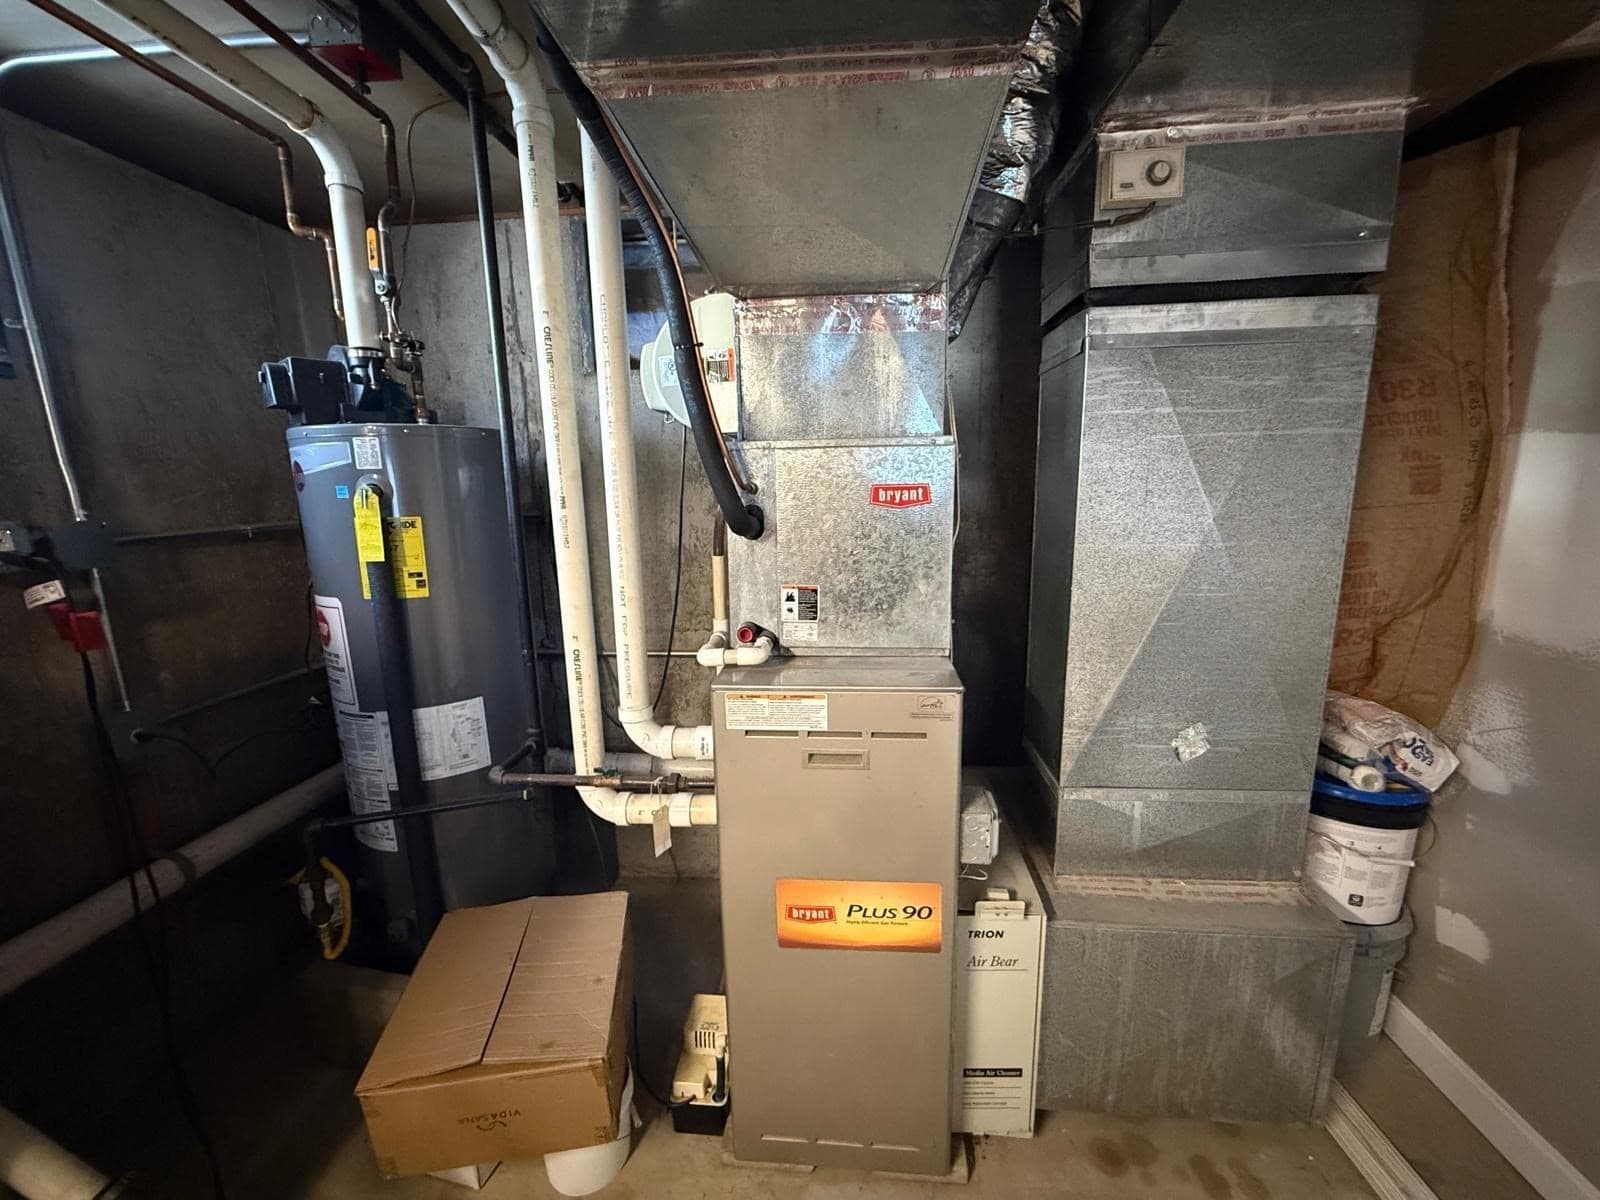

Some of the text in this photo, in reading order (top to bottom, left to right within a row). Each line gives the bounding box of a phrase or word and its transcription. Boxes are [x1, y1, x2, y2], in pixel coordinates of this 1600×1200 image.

[1376, 376, 1437, 403] R30
[878, 487, 924, 503] bryant
[792, 904, 933, 920] bryant PLUS 90
[967, 930, 1005, 939] TRION
[966, 955, 1020, 968] Air Bear
